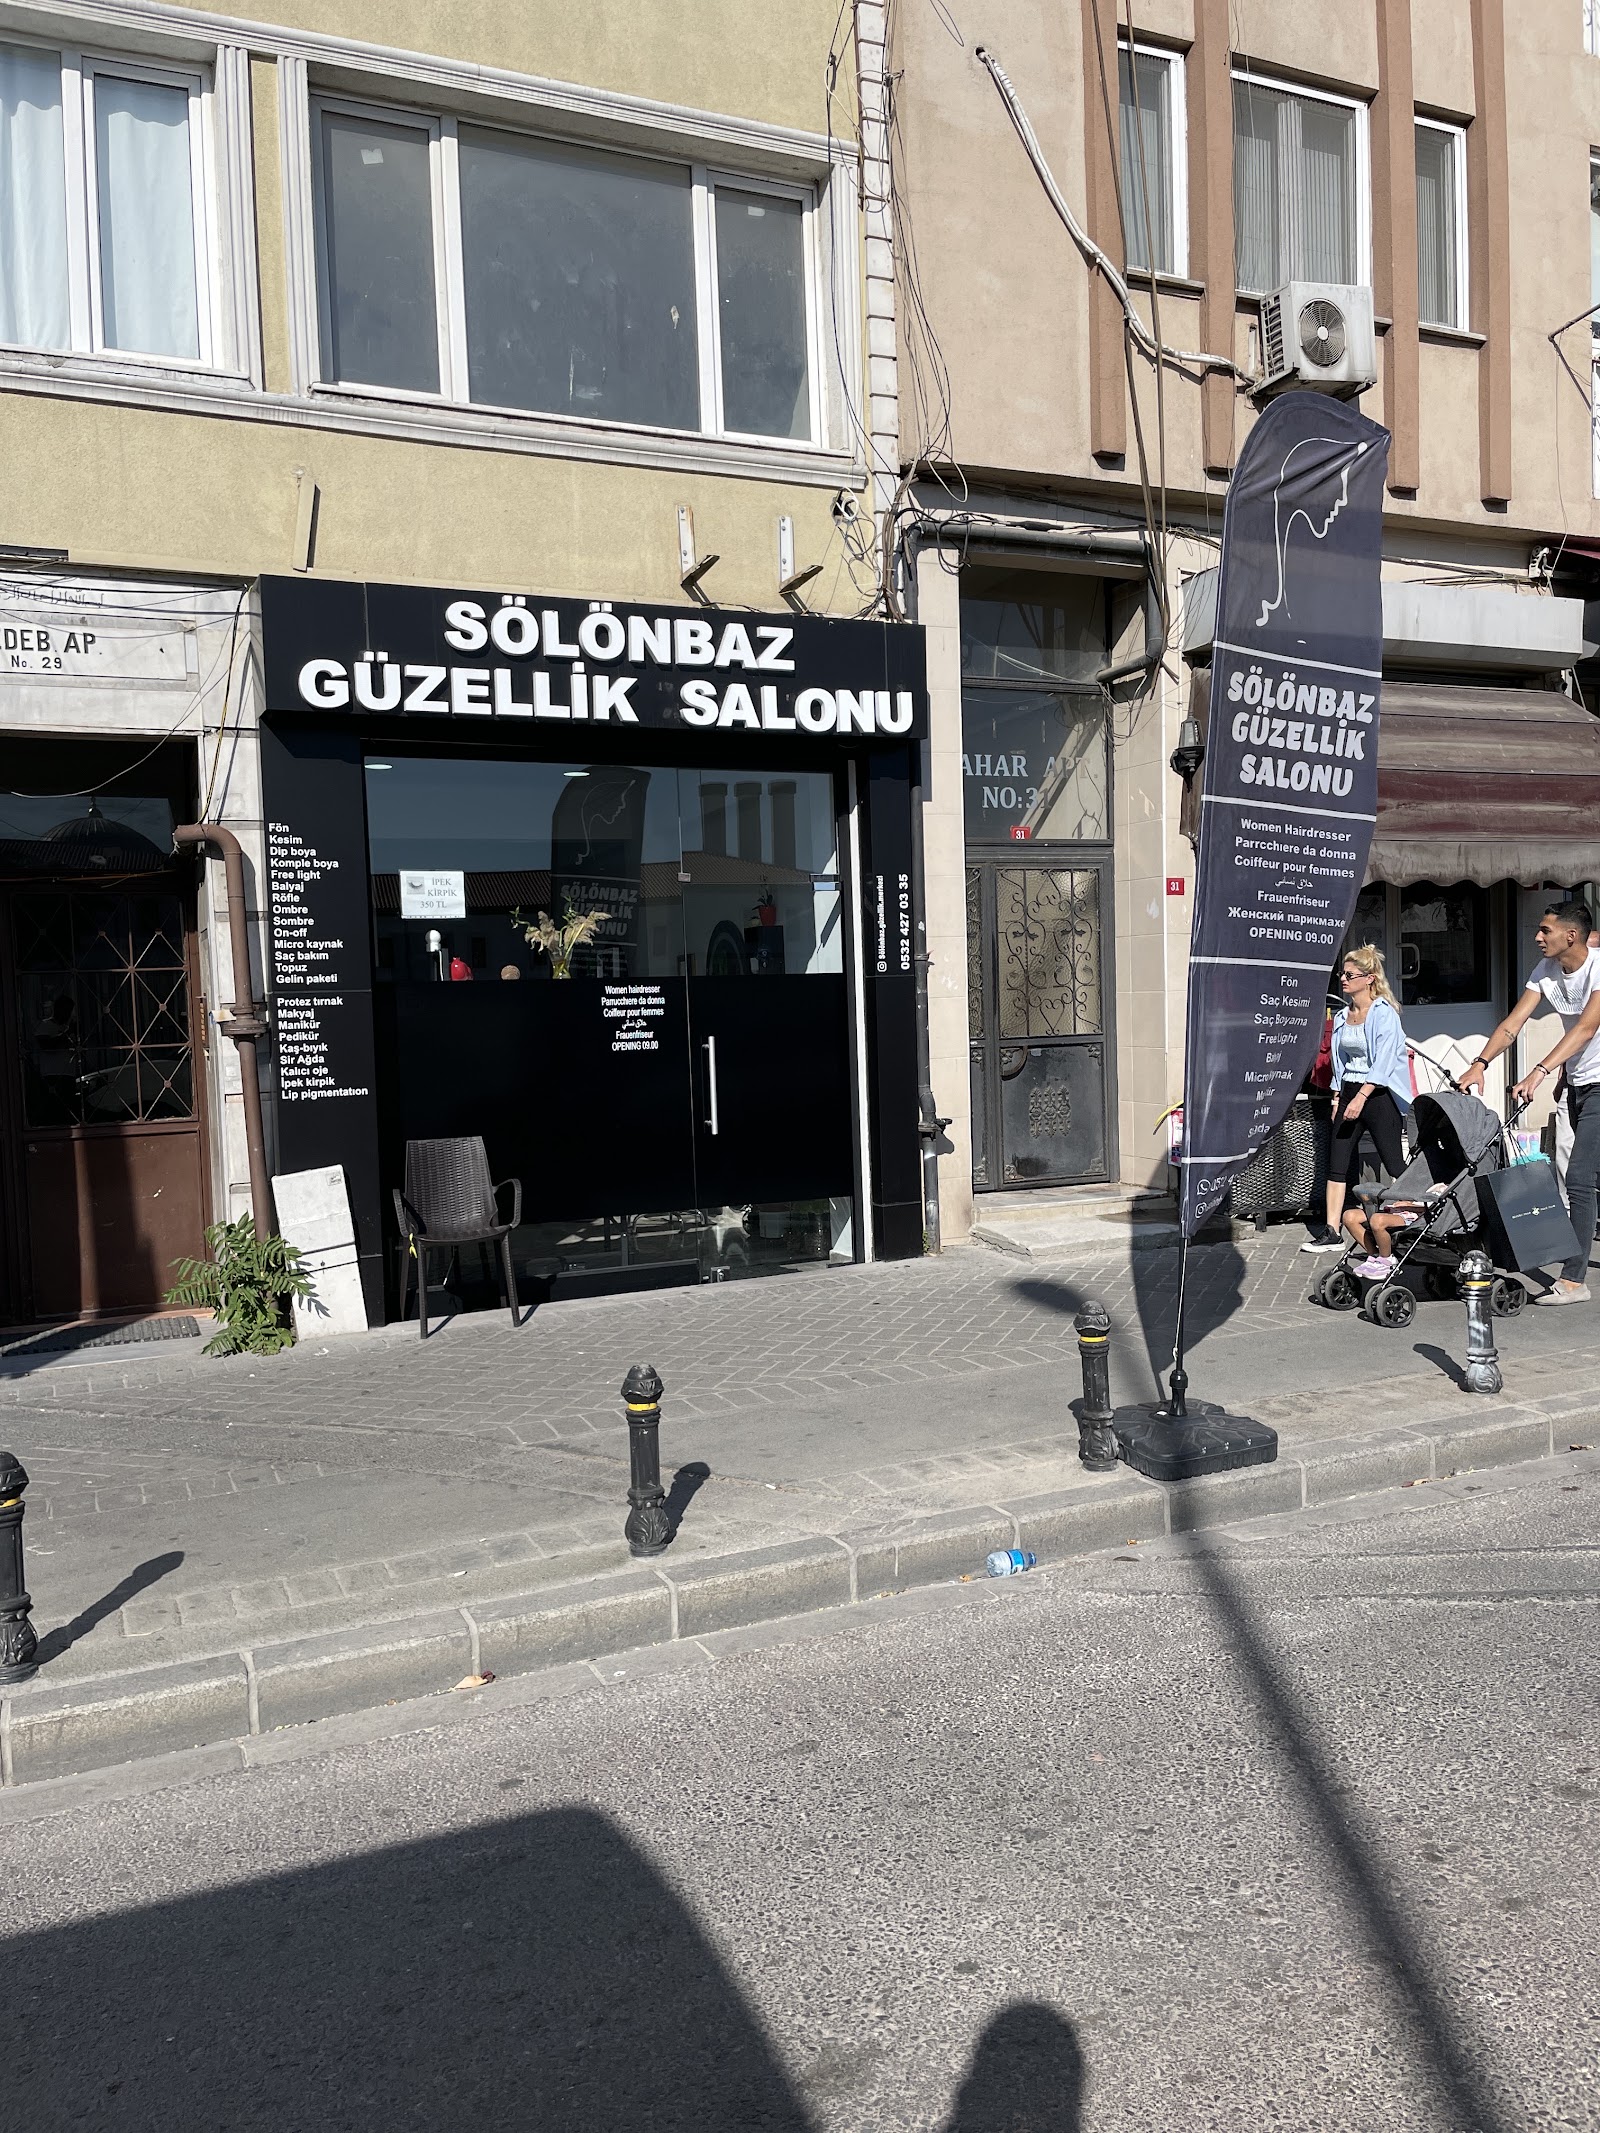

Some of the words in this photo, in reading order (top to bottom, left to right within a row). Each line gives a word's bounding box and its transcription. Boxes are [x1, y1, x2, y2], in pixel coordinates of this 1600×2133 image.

[444, 595, 795, 671] SÖLÖNBAZ
[0, 628, 57, 652] DEB.
[42, 656, 62, 669] 29
[297, 651, 639, 723] GÜZELLİK
[680, 679, 914, 734] SALONU
[1227, 665, 1376, 724] SÖLÖNBAZ
[1231, 706, 1366, 761] GÜZELLİK
[963, 754, 1029, 777] AHAR
[1239, 754, 1354, 797] SALONU
[982, 786, 1051, 809] NO:31
[268, 823, 289, 833] Fön
[1240, 817, 1282, 834] Women
[1284, 824, 1352, 842] Hairdresser
[269, 835, 303, 844] Kesim
[1015, 830, 1025, 840] 31
[270, 847, 288, 857] Dip
[291, 847, 317, 858] boya
[1302, 844, 1317, 857] da
[1319, 846, 1357, 861] donna
[270, 858, 311, 869] Komple
[313, 859, 339, 870] boya
[1234, 855, 1280, 871] Coiffeur
[1282, 861, 1307, 875] pour
[1309, 862, 1355, 878] femmes
[271, 870, 294, 879] Free
[297, 870, 321, 881] light
[272, 882, 304, 892] Balyaj
[432, 877, 452, 886] İPEK
[898, 873, 909, 890] 35
[1170, 881, 1180, 891] 31
[1296, 878, 1314, 890] حلاق
[272, 893, 300, 903] Röfle
[427, 889, 457, 897] KİRPİK
[420, 901, 434, 909] 350
[436, 901, 447, 909] TL
[899, 892, 909, 909] 03
[1257, 890, 1330, 909] Frauenfriseur
[273, 905, 309, 914] Ombre
[273, 916, 315, 926] Sombre
[1228, 906, 1284, 922] Женский
[1287, 912, 1346, 928] парикмахе
[900, 912, 910, 936] 427
[274, 928, 308, 937] On-off
[1249, 927, 1302, 941] OPENING
[1305, 932, 1334, 945] 09.00
[274, 939, 304, 949] Micro
[306, 939, 344, 950] kaynak
[275, 951, 296, 962] Saç
[297, 951, 329, 960] bakım
[900, 938, 910, 970] 0532
[275, 963, 308, 973] Topuz
[276, 974, 304, 984] Gelin
[306, 974, 338, 985] paketi
[1281, 976, 1298, 988] Fön
[605, 986, 627, 994] Women
[628, 985, 661, 994] hairdresser
[277, 998, 311, 1007] Protez
[313, 996, 343, 1006] tırnak
[638, 996, 646, 1004] da
[647, 996, 665, 1005] donna
[1260, 994, 1280, 1008] Saç
[278, 1009, 314, 1020] Makyaj
[603, 1008, 626, 1017] Coiffeur
[627, 1009, 640, 1018] pour
[641, 1007, 664, 1016] femmes
[278, 1020, 321, 1030] Manikür
[1254, 1013, 1274, 1027] Saç
[1275, 1014, 1308, 1027] Boyama
[279, 1032, 319, 1041] Pedikür
[616, 1030, 654, 1039] Frauenfriseur
[279, 1043, 328, 1054] Kaş-bıyık
[612, 1041, 641, 1051] OPENING
[642, 1041, 659, 1050] 09.00
[280, 1055, 296, 1065] Sir
[297, 1055, 325, 1066] Ağda
[312, 1066, 329, 1077] oje
[281, 1077, 304, 1089] İpek
[305, 1077, 335, 1088] kirpik
[282, 1090, 299, 1101] Lip
